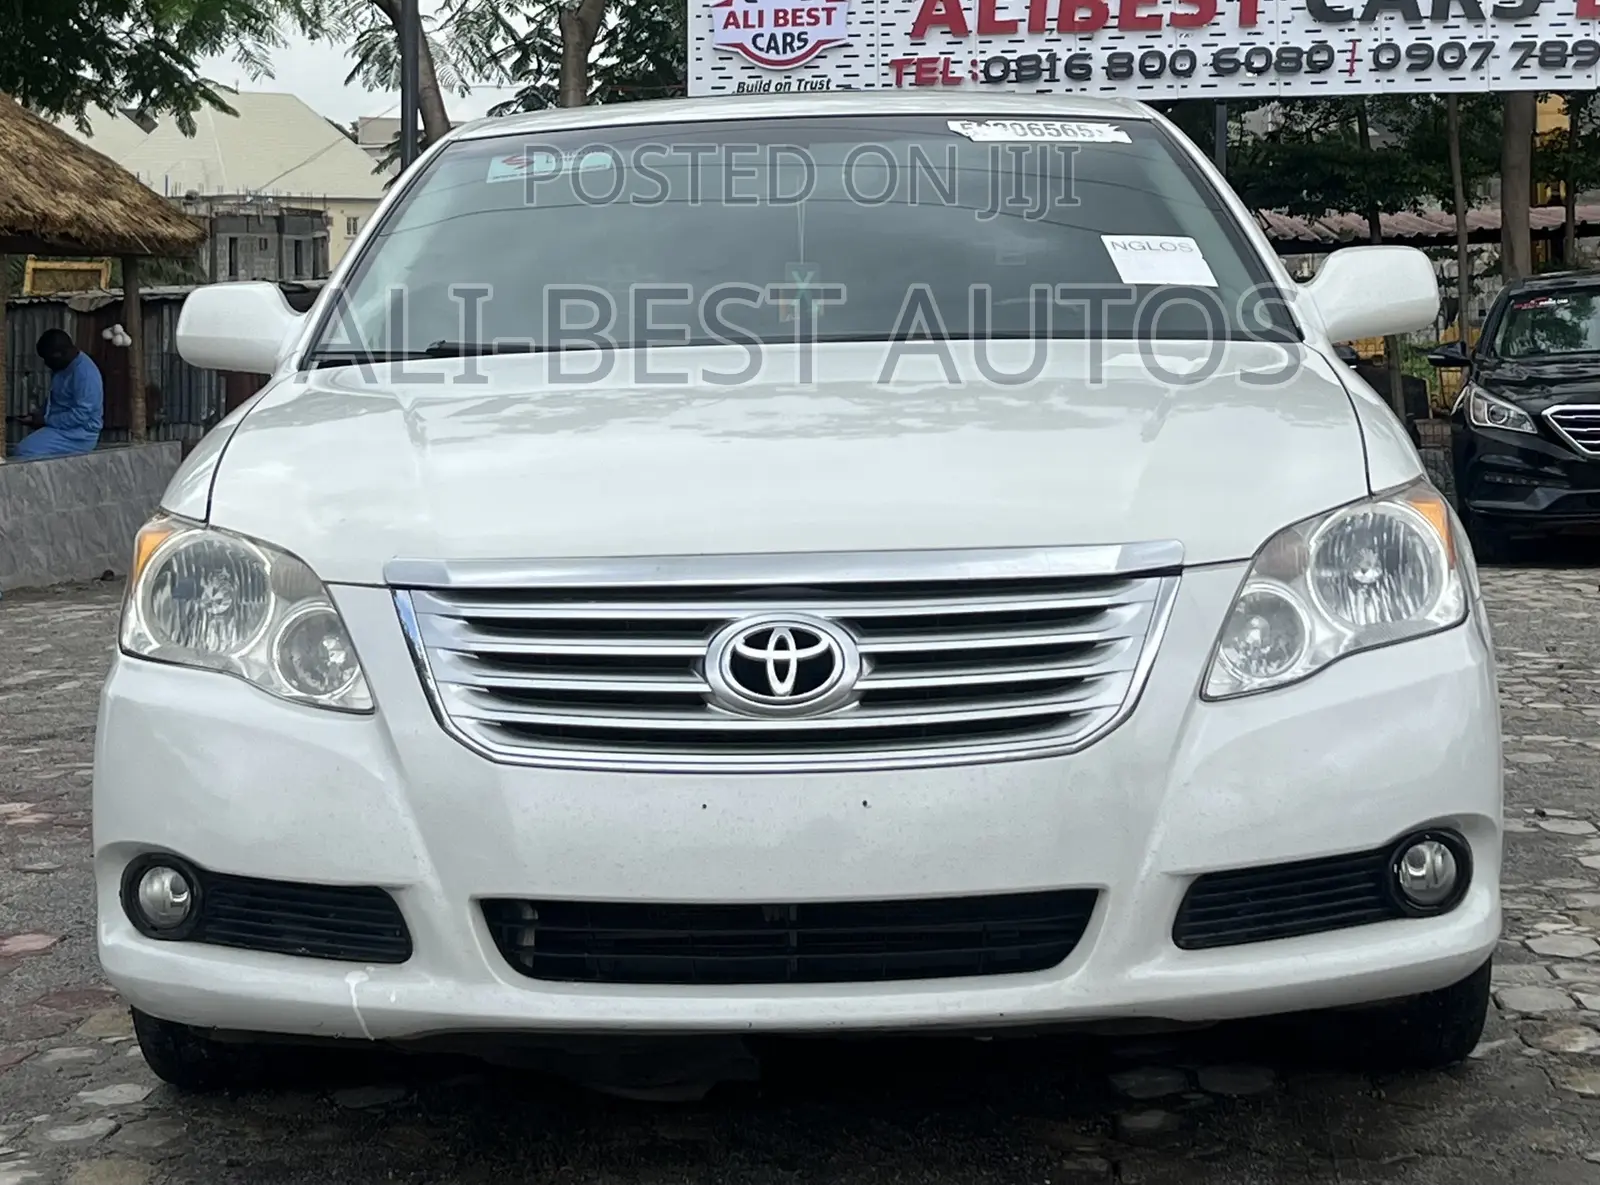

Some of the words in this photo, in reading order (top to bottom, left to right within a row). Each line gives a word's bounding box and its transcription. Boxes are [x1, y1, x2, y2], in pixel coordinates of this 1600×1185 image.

[722, 9, 764, 29] ALI
[773, 7, 837, 27] BEST
[751, 31, 809, 55] CARS
[1106, 49, 1197, 80] 800
[1373, 41, 1495, 72] 0907
[1510, 39, 1600, 70] 789
[736, 79, 772, 93] Build
[774, 82, 791, 92] on
[796, 78, 831, 91] Trust
